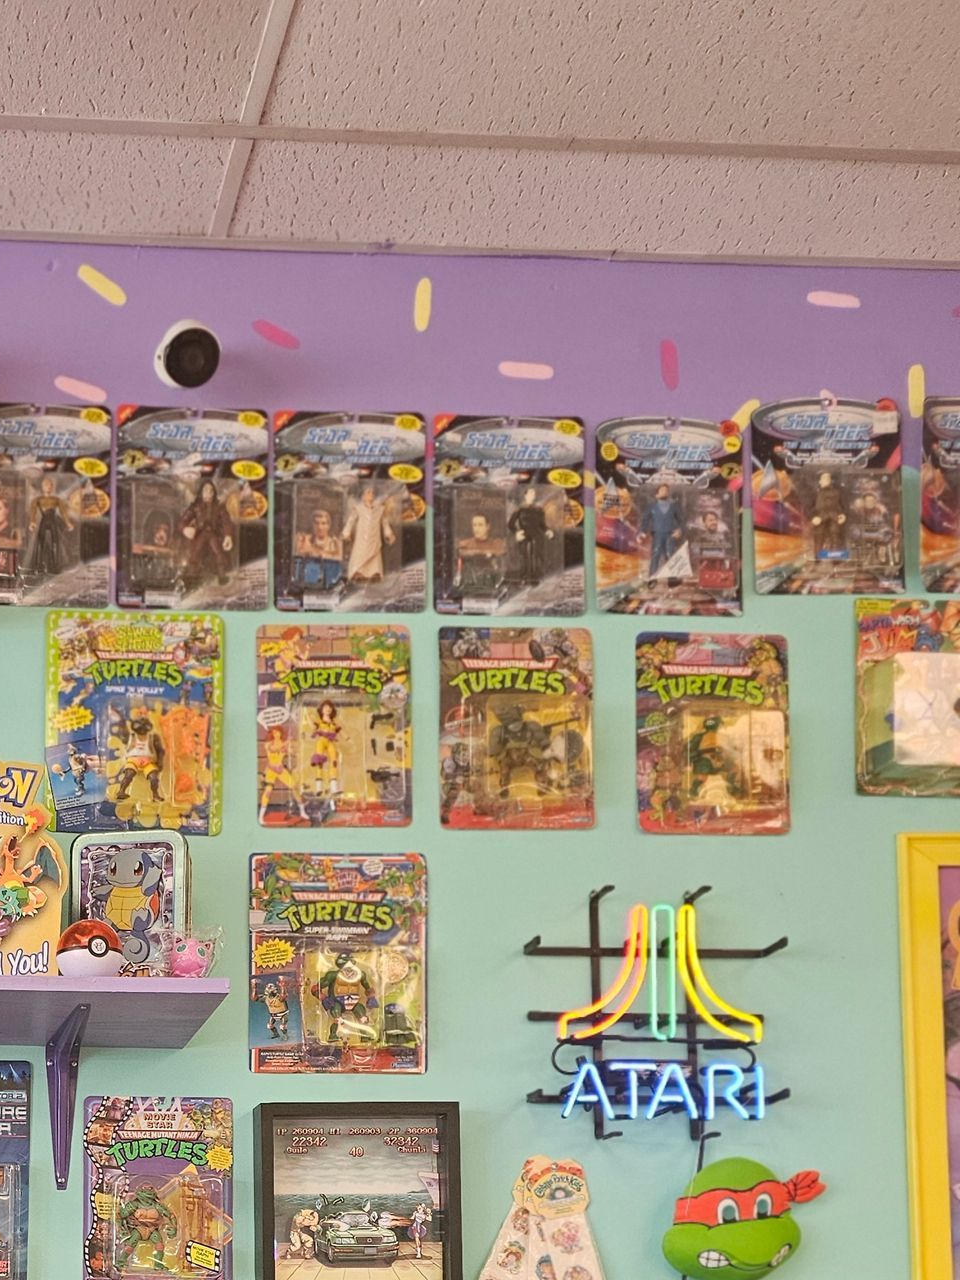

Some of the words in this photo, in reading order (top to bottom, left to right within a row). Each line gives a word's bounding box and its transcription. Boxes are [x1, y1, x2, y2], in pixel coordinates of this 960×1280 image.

[147, 422, 192, 438] STAR
[465, 432, 510, 448] STAR
[626, 432, 670, 449] STAR
[84, 660, 184, 688] TURTLES
[279, 668, 384, 696] TURTLES
[448, 669, 566, 699] TURTLES
[649, 672, 765, 706] TURTLES
[277, 901, 395, 932] TURTLES
[7, 942, 50, 976] You!
[561, 1063, 766, 1120] ATARI
[143, 1113, 177, 1121] MOVIE
[120, 1131, 150, 1139] TEENAGE
[151, 1131, 176, 1139] MUTANT
[177, 1132, 199, 1140] NINJA
[292, 1136, 328, 1147] 22342
[105, 1139, 209, 1166] TURTLES
[349, 1147, 365, 1157] 40
